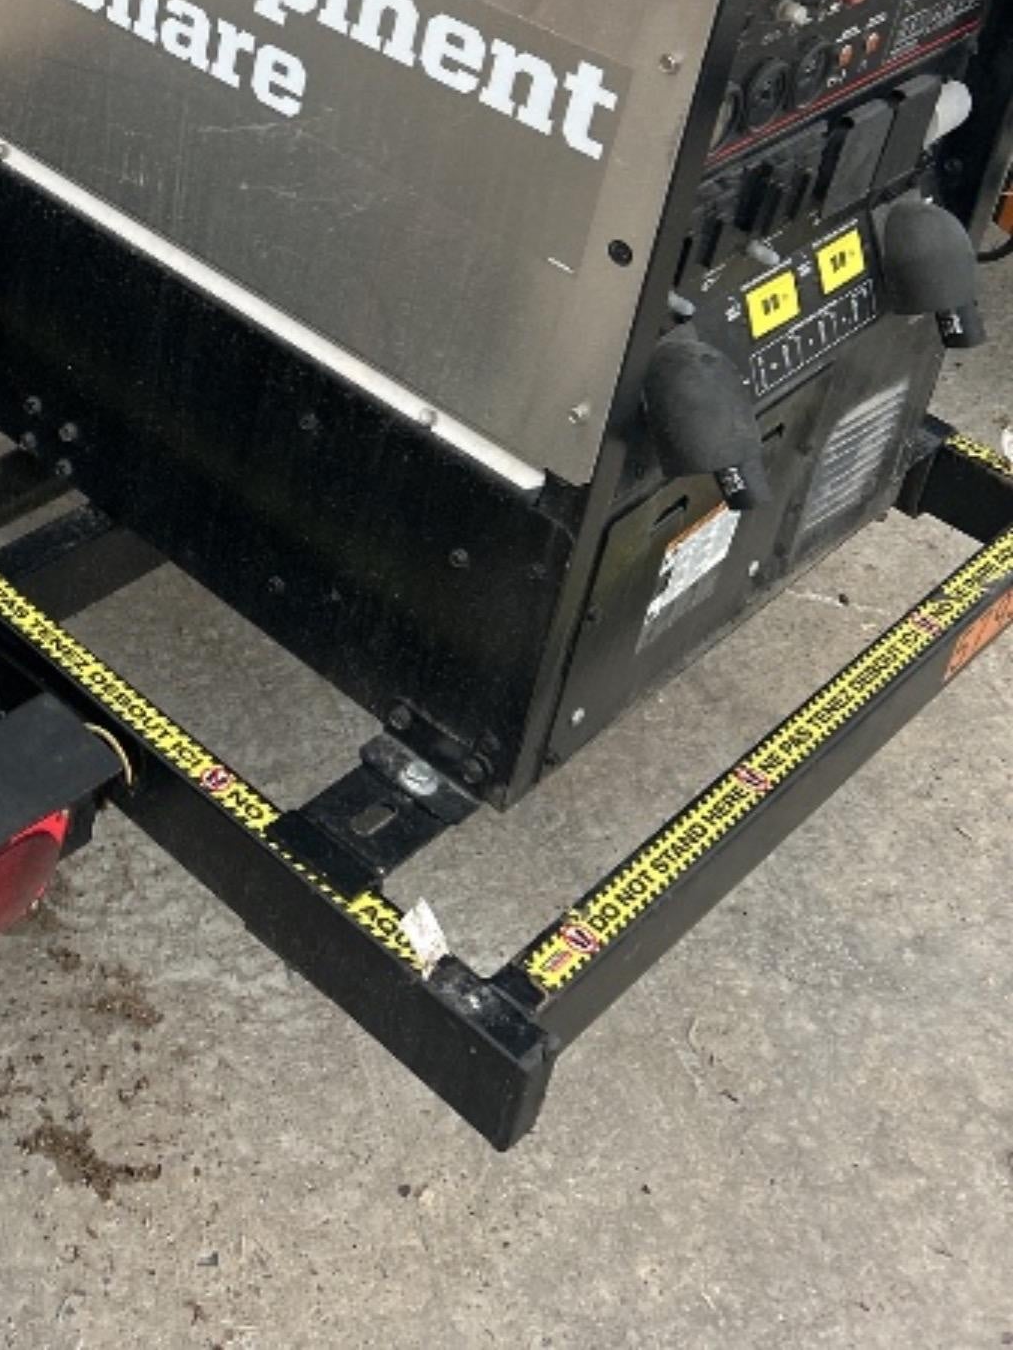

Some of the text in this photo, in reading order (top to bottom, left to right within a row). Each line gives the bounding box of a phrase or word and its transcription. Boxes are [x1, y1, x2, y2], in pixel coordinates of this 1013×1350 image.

[32, 617, 90, 673] TENEZ
[90, 671, 174, 740] DEBOUT
[779, 725, 814, 753] PAS
[227, 789, 264, 819] NO
[588, 785, 750, 933] DO NOT STAND HERE
